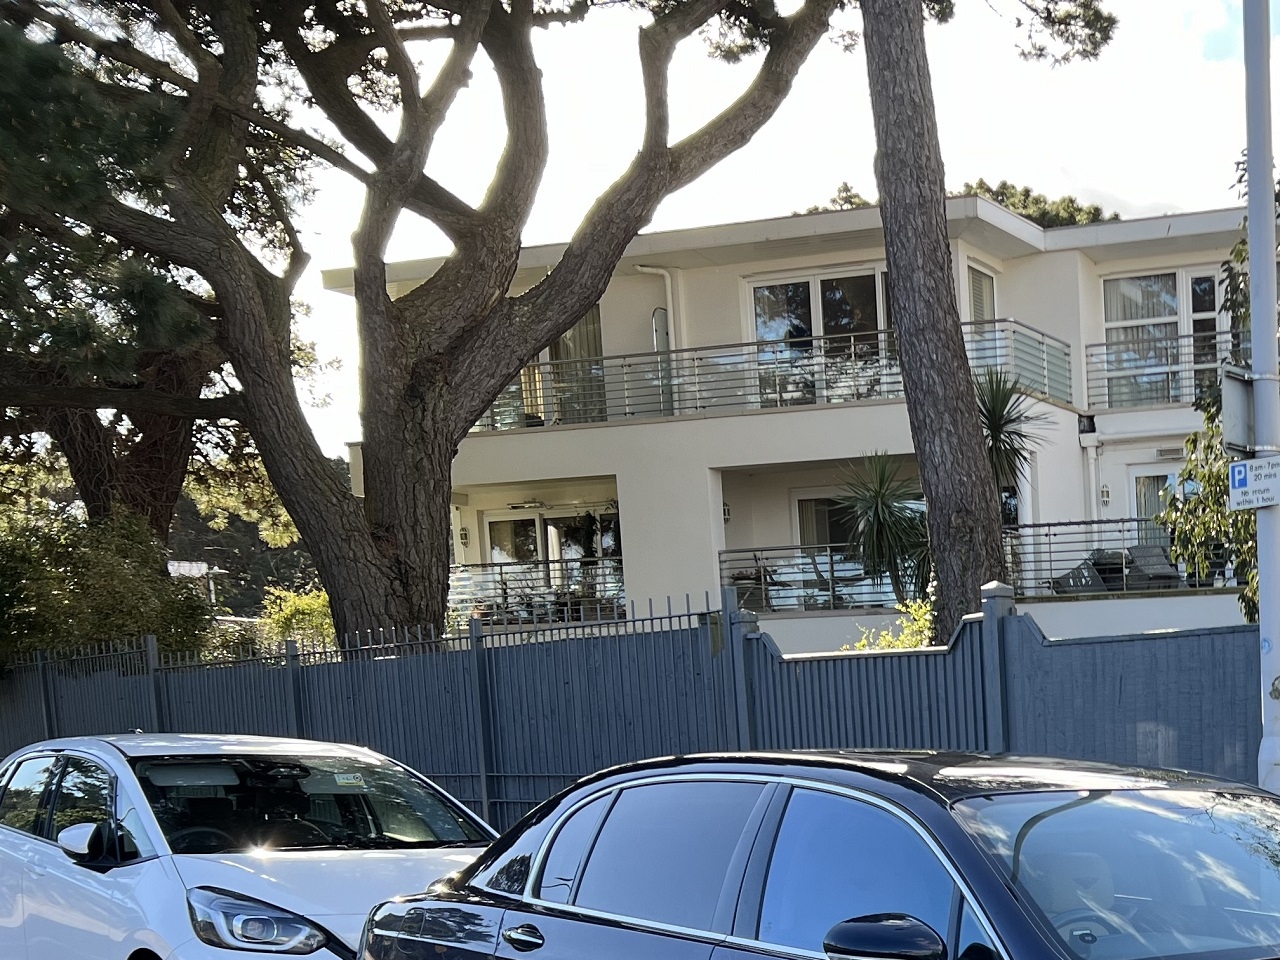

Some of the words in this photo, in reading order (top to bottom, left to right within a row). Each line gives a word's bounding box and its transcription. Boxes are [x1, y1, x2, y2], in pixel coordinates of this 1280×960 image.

[1235, 466, 1245, 488] P
[1254, 473, 1262, 481] 20
[1252, 488, 1270, 496] return
[1236, 498, 1254, 507] within
